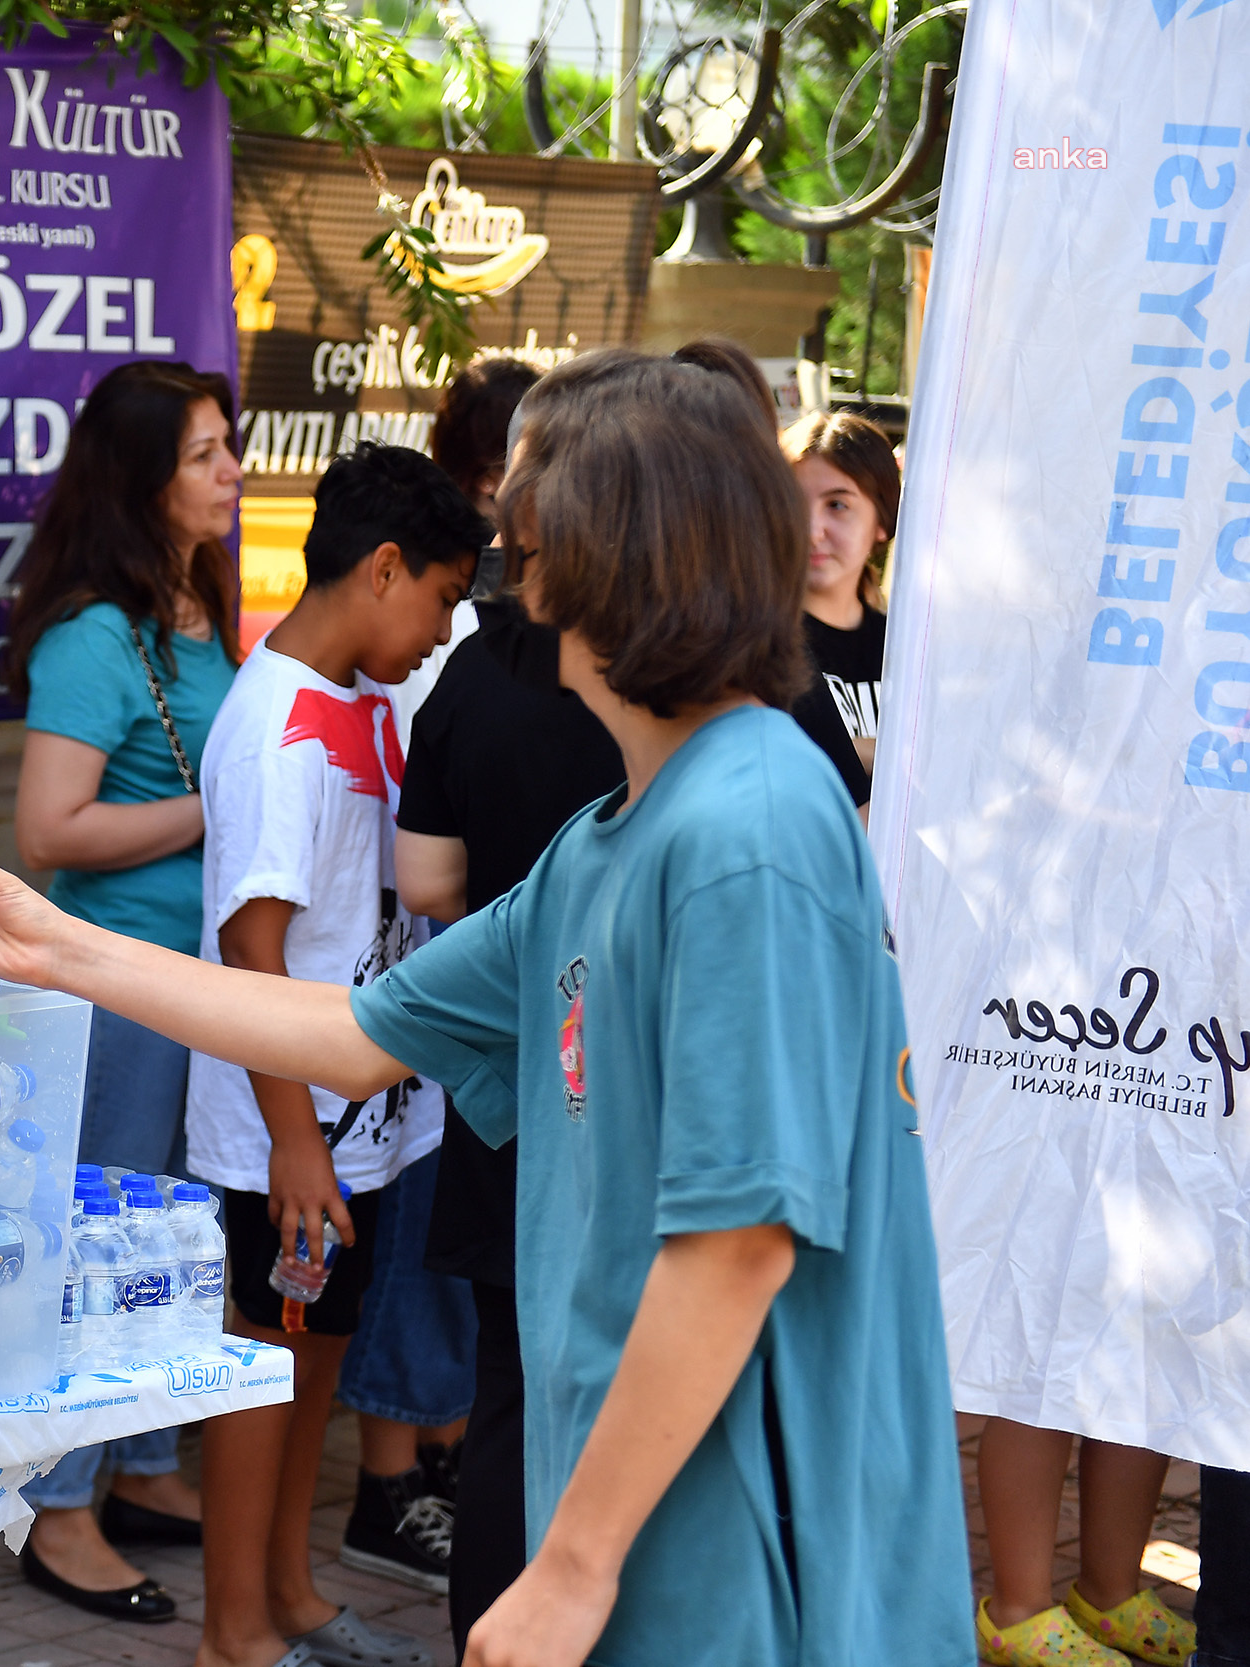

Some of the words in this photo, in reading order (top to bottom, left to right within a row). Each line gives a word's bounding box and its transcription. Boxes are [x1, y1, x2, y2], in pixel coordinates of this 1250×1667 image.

[4, 67, 184, 159] KÜLTÜR
[10, 168, 113, 209] KURSU
[171, 1363, 230, 1391] Olsun
